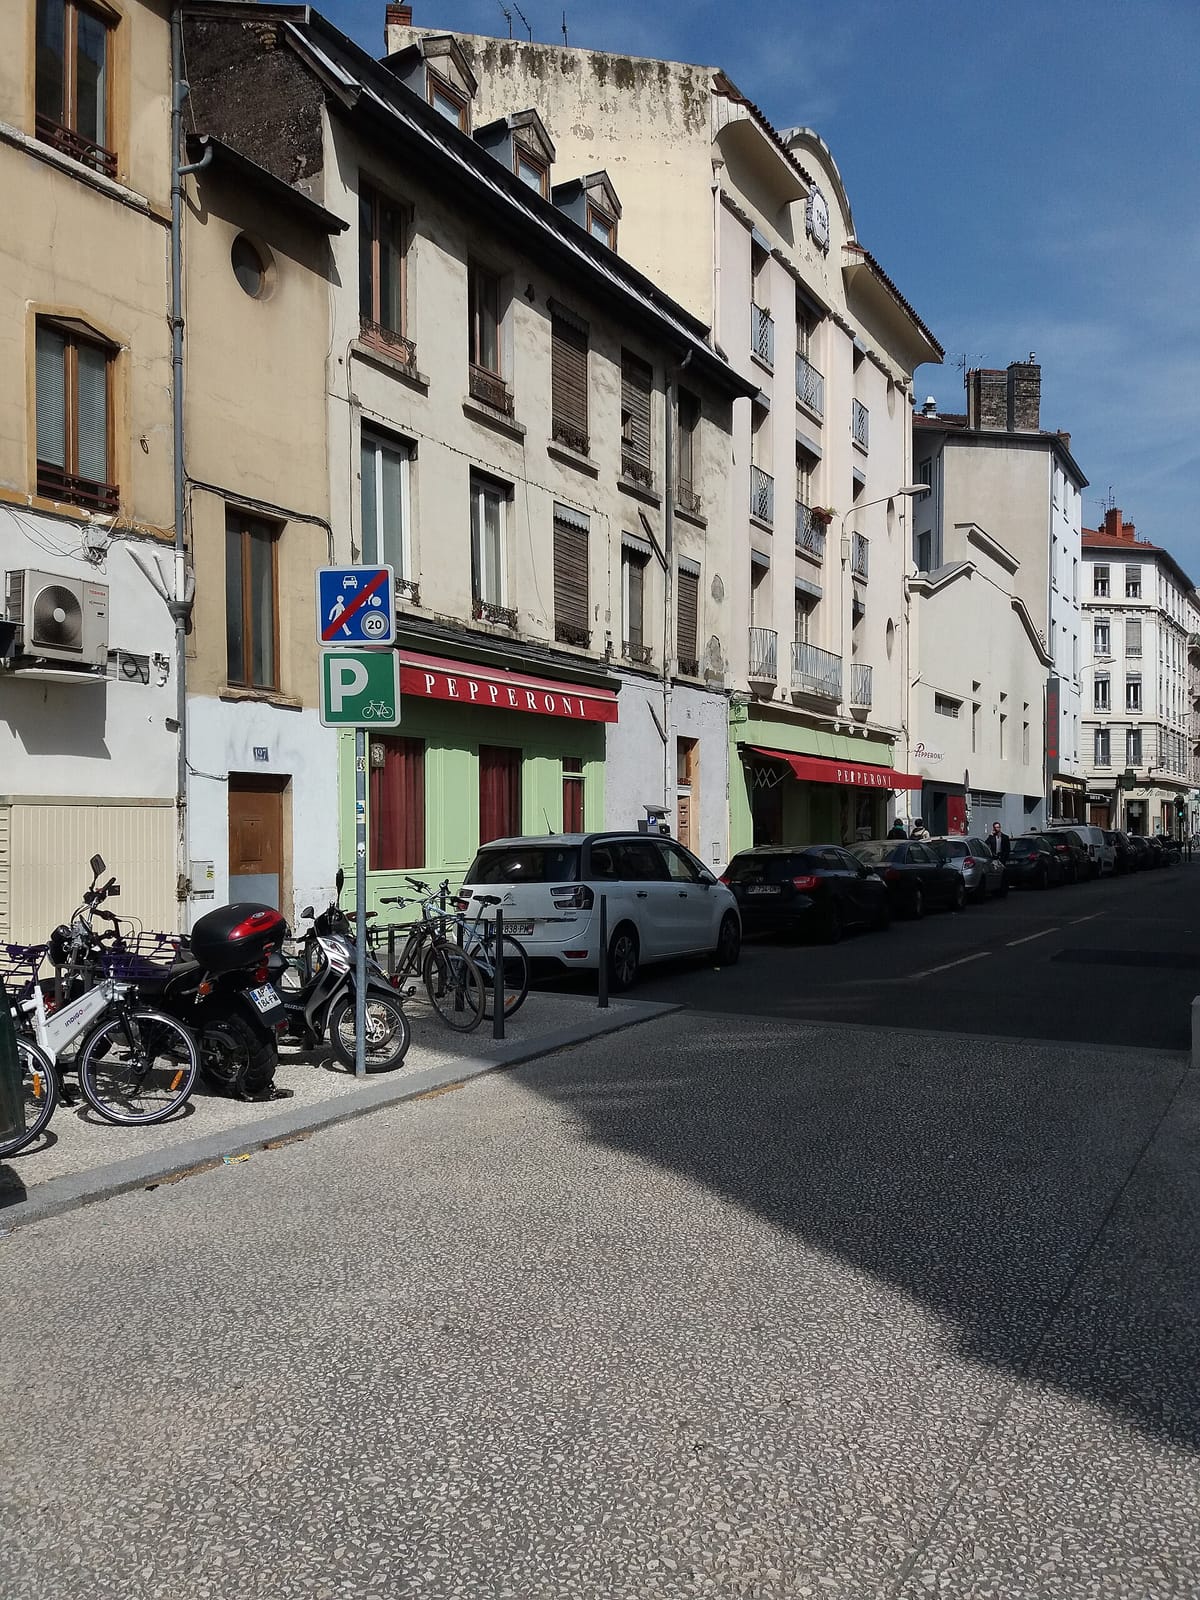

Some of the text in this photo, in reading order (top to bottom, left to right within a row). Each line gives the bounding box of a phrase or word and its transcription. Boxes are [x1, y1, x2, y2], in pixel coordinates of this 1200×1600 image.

[367, 619, 382, 630] 20
[329, 658, 369, 713] P
[424, 673, 586, 717] PEPPERONI
[837, 769, 891, 787] PEPPERONI
[649, 815, 656, 824] P
